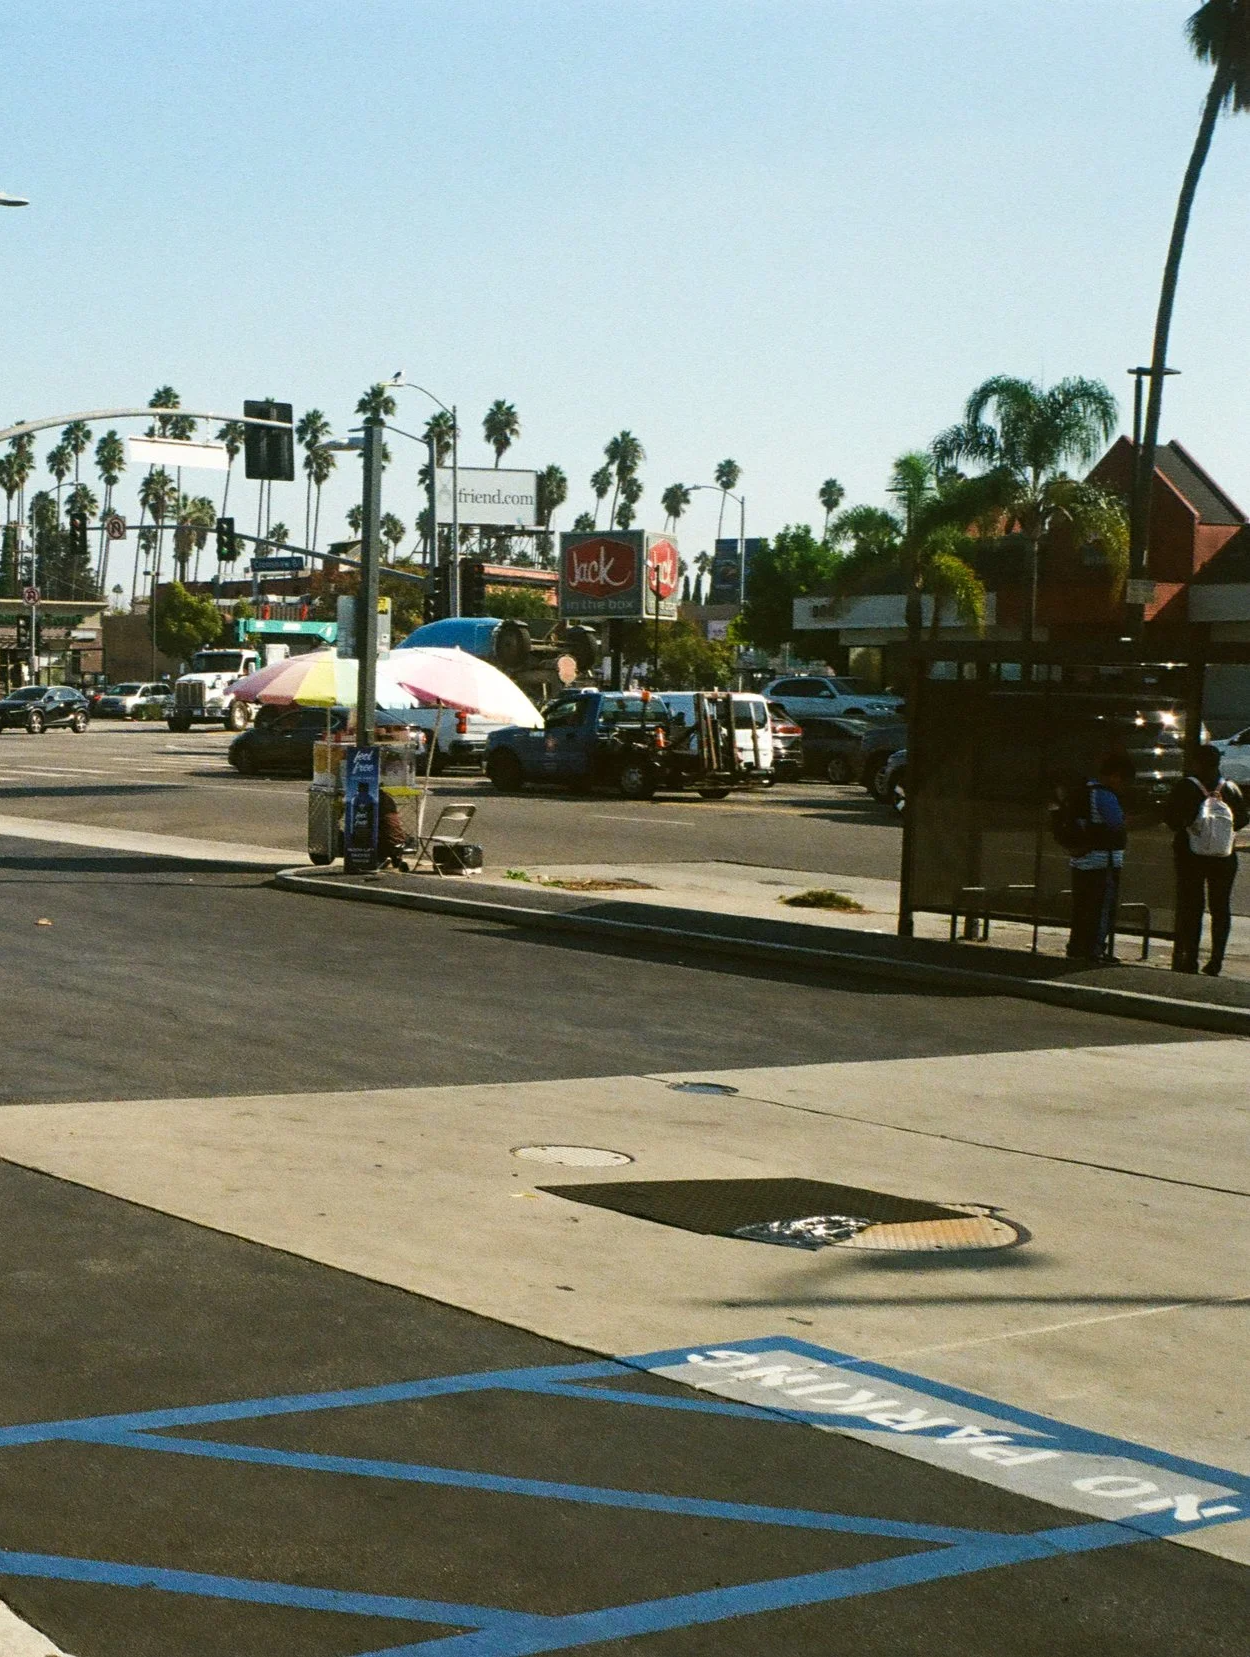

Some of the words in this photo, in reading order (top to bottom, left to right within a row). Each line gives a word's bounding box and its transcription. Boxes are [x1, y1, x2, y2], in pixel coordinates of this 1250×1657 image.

[458, 487, 534, 506] friend.com
[570, 546, 631, 587] Jack
[582, 600, 605, 609] the
[609, 600, 634, 609] box
[352, 762, 375, 775] free
[686, 1349, 1061, 1467] PARKING
[1071, 1474, 1241, 1522] NO
